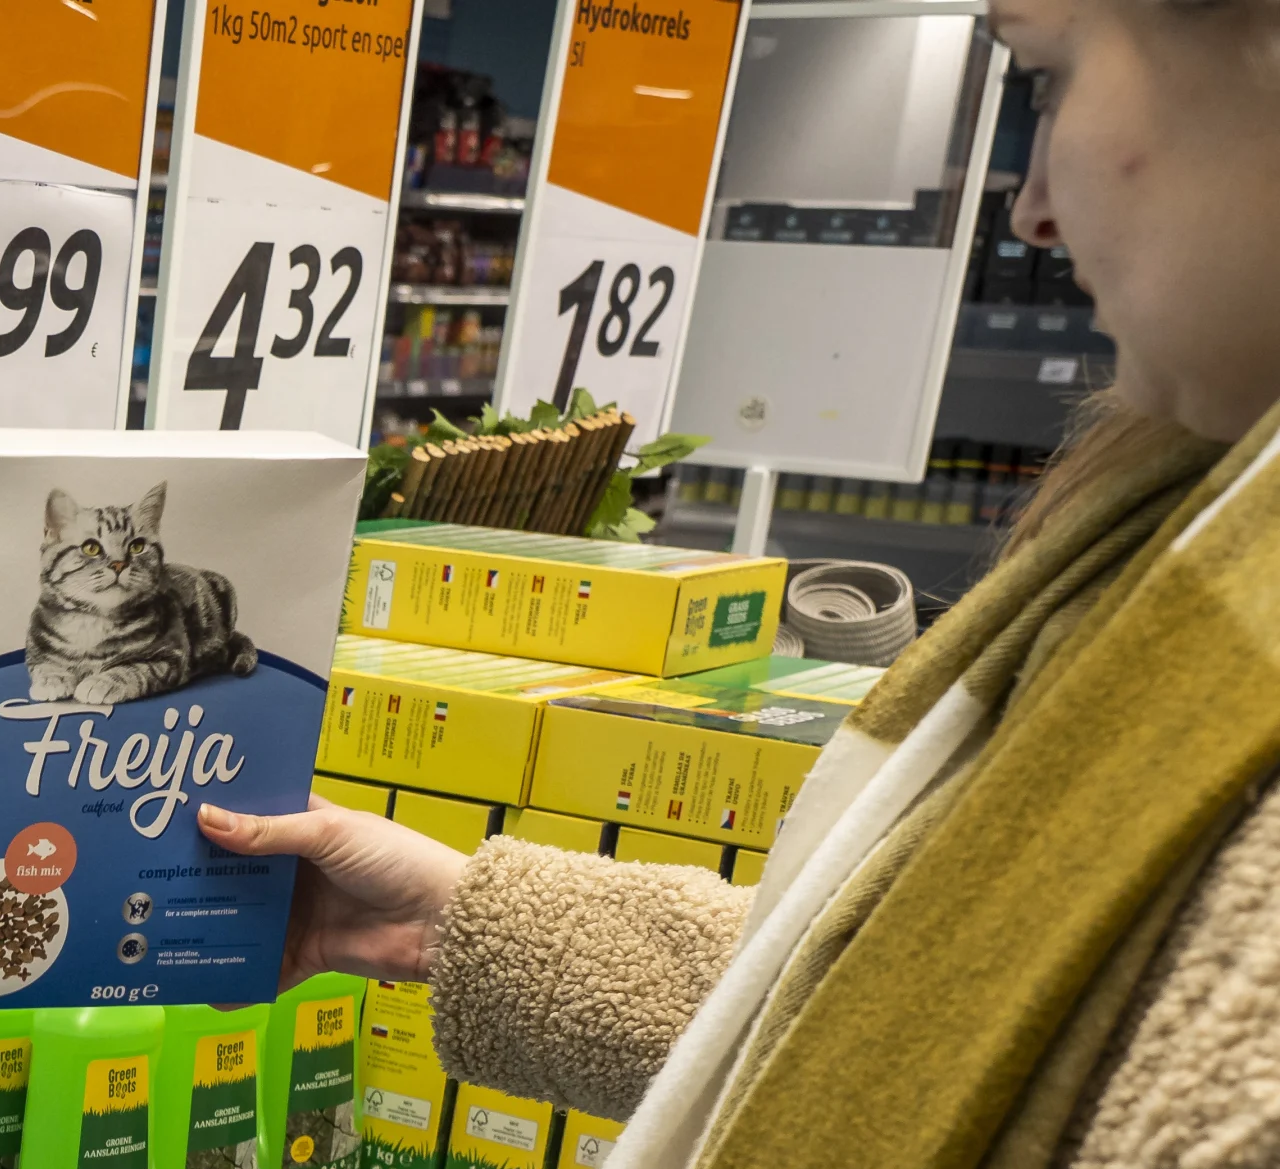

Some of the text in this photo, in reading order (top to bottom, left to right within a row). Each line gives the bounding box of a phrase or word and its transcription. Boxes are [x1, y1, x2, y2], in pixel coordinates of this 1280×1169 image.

[577, 0, 692, 40] Hydrokorrels
[211, 5, 244, 44] 1kg
[248, 10, 298, 45] 50m2
[302, 23, 348, 54] sport
[351, 30, 372, 54] en
[81, 799, 124, 818] catfood
[16, 864, 62, 877] fish mix
[138, 862, 270, 880] complete nutrition
[180, 909, 208, 918] complete
[209, 908, 238, 916] nutrition
[157, 955, 246, 966] fresh salmon and vegetables
[158, 949, 200, 958] with sardine,
[90, 985, 140, 1002] 800 g
[216, 1040, 244, 1056] Green
[216, 1053, 244, 1072] Boots
[108, 1067, 137, 1083] Green
[108, 1080, 137, 1099] Boots
[194, 1110, 254, 1129] AANSLAG REINIGER
[214, 1106, 240, 1118] GROENE
[83, 1141, 146, 1159] AANSLAG REINIGER
[105, 1136, 133, 1148] GROENE
